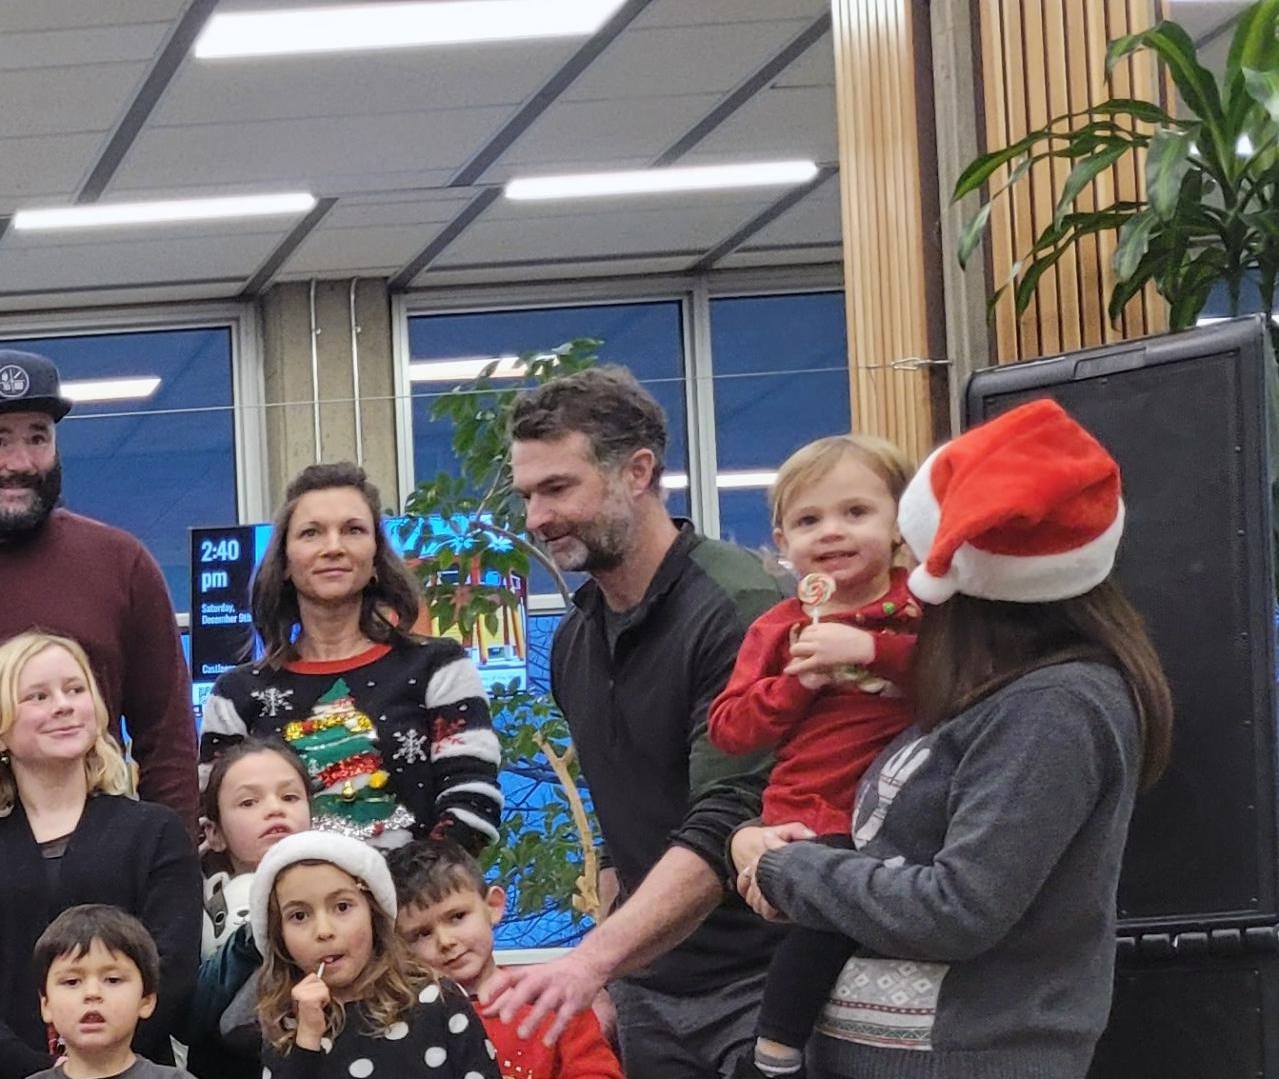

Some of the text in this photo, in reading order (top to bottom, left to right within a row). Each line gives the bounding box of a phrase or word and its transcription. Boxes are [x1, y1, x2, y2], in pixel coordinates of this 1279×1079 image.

[201, 539, 239, 562] 2:40
[201, 571, 228, 592] pm
[202, 603, 235, 613] Saturday,
[202, 614, 237, 624] December
